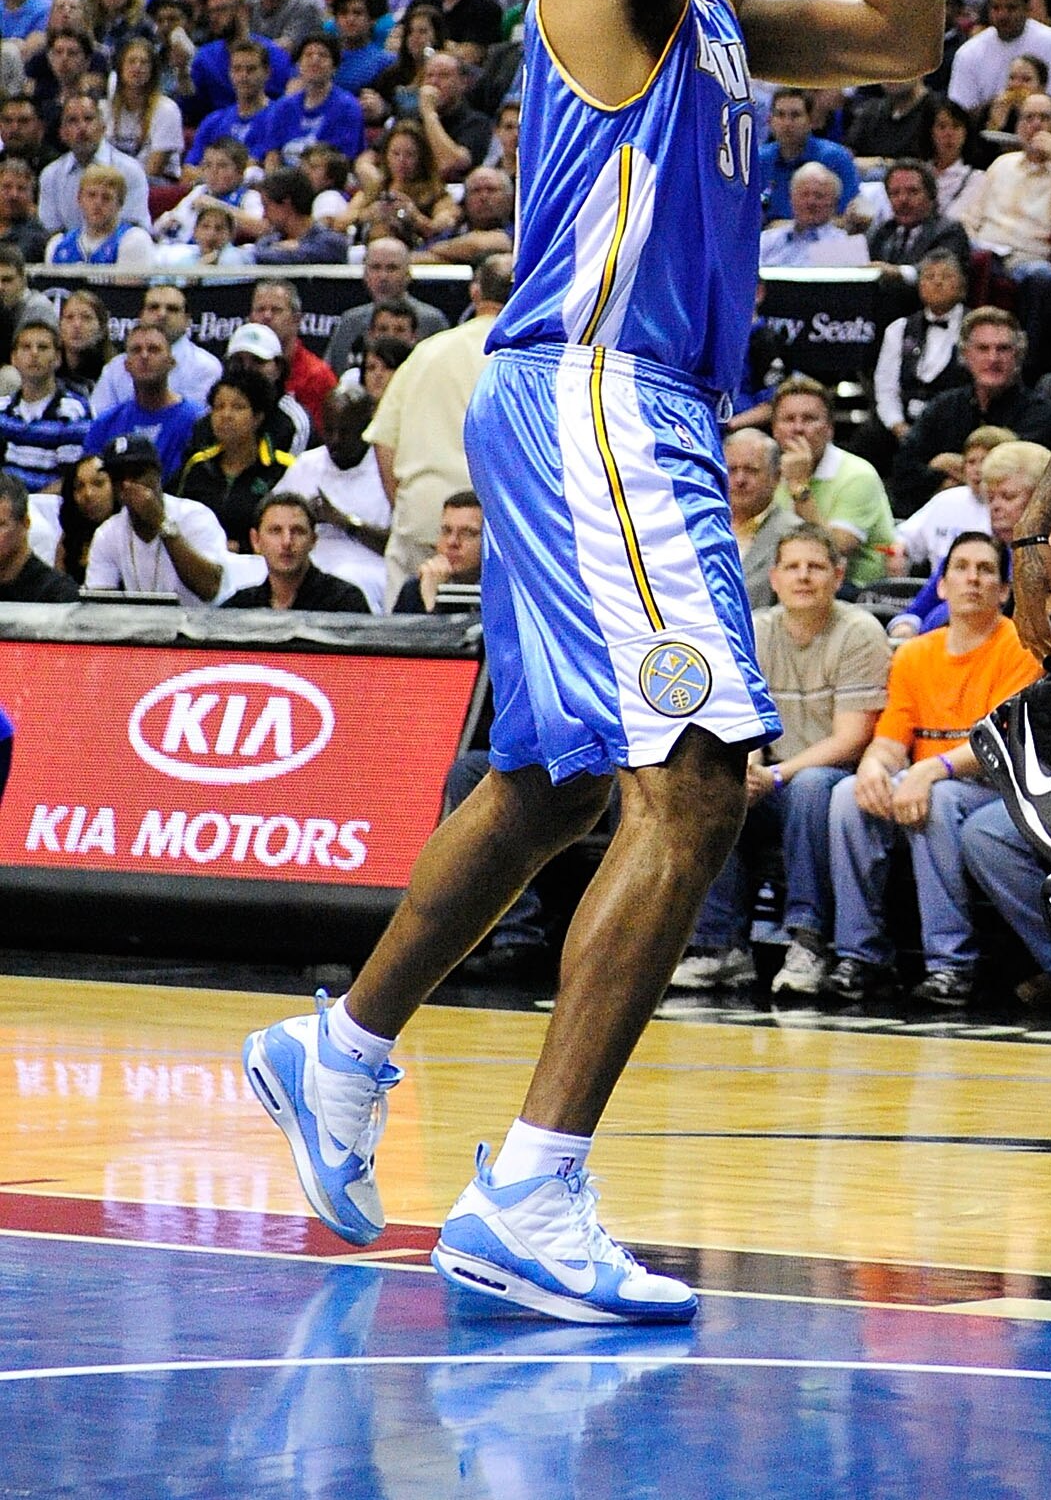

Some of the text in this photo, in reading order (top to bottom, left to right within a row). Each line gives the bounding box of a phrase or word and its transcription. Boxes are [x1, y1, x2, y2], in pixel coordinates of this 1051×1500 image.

[808, 312, 876, 343] Seats
[162, 693, 293, 756] KIA
[25, 804, 371, 871] KIA MOTORS
